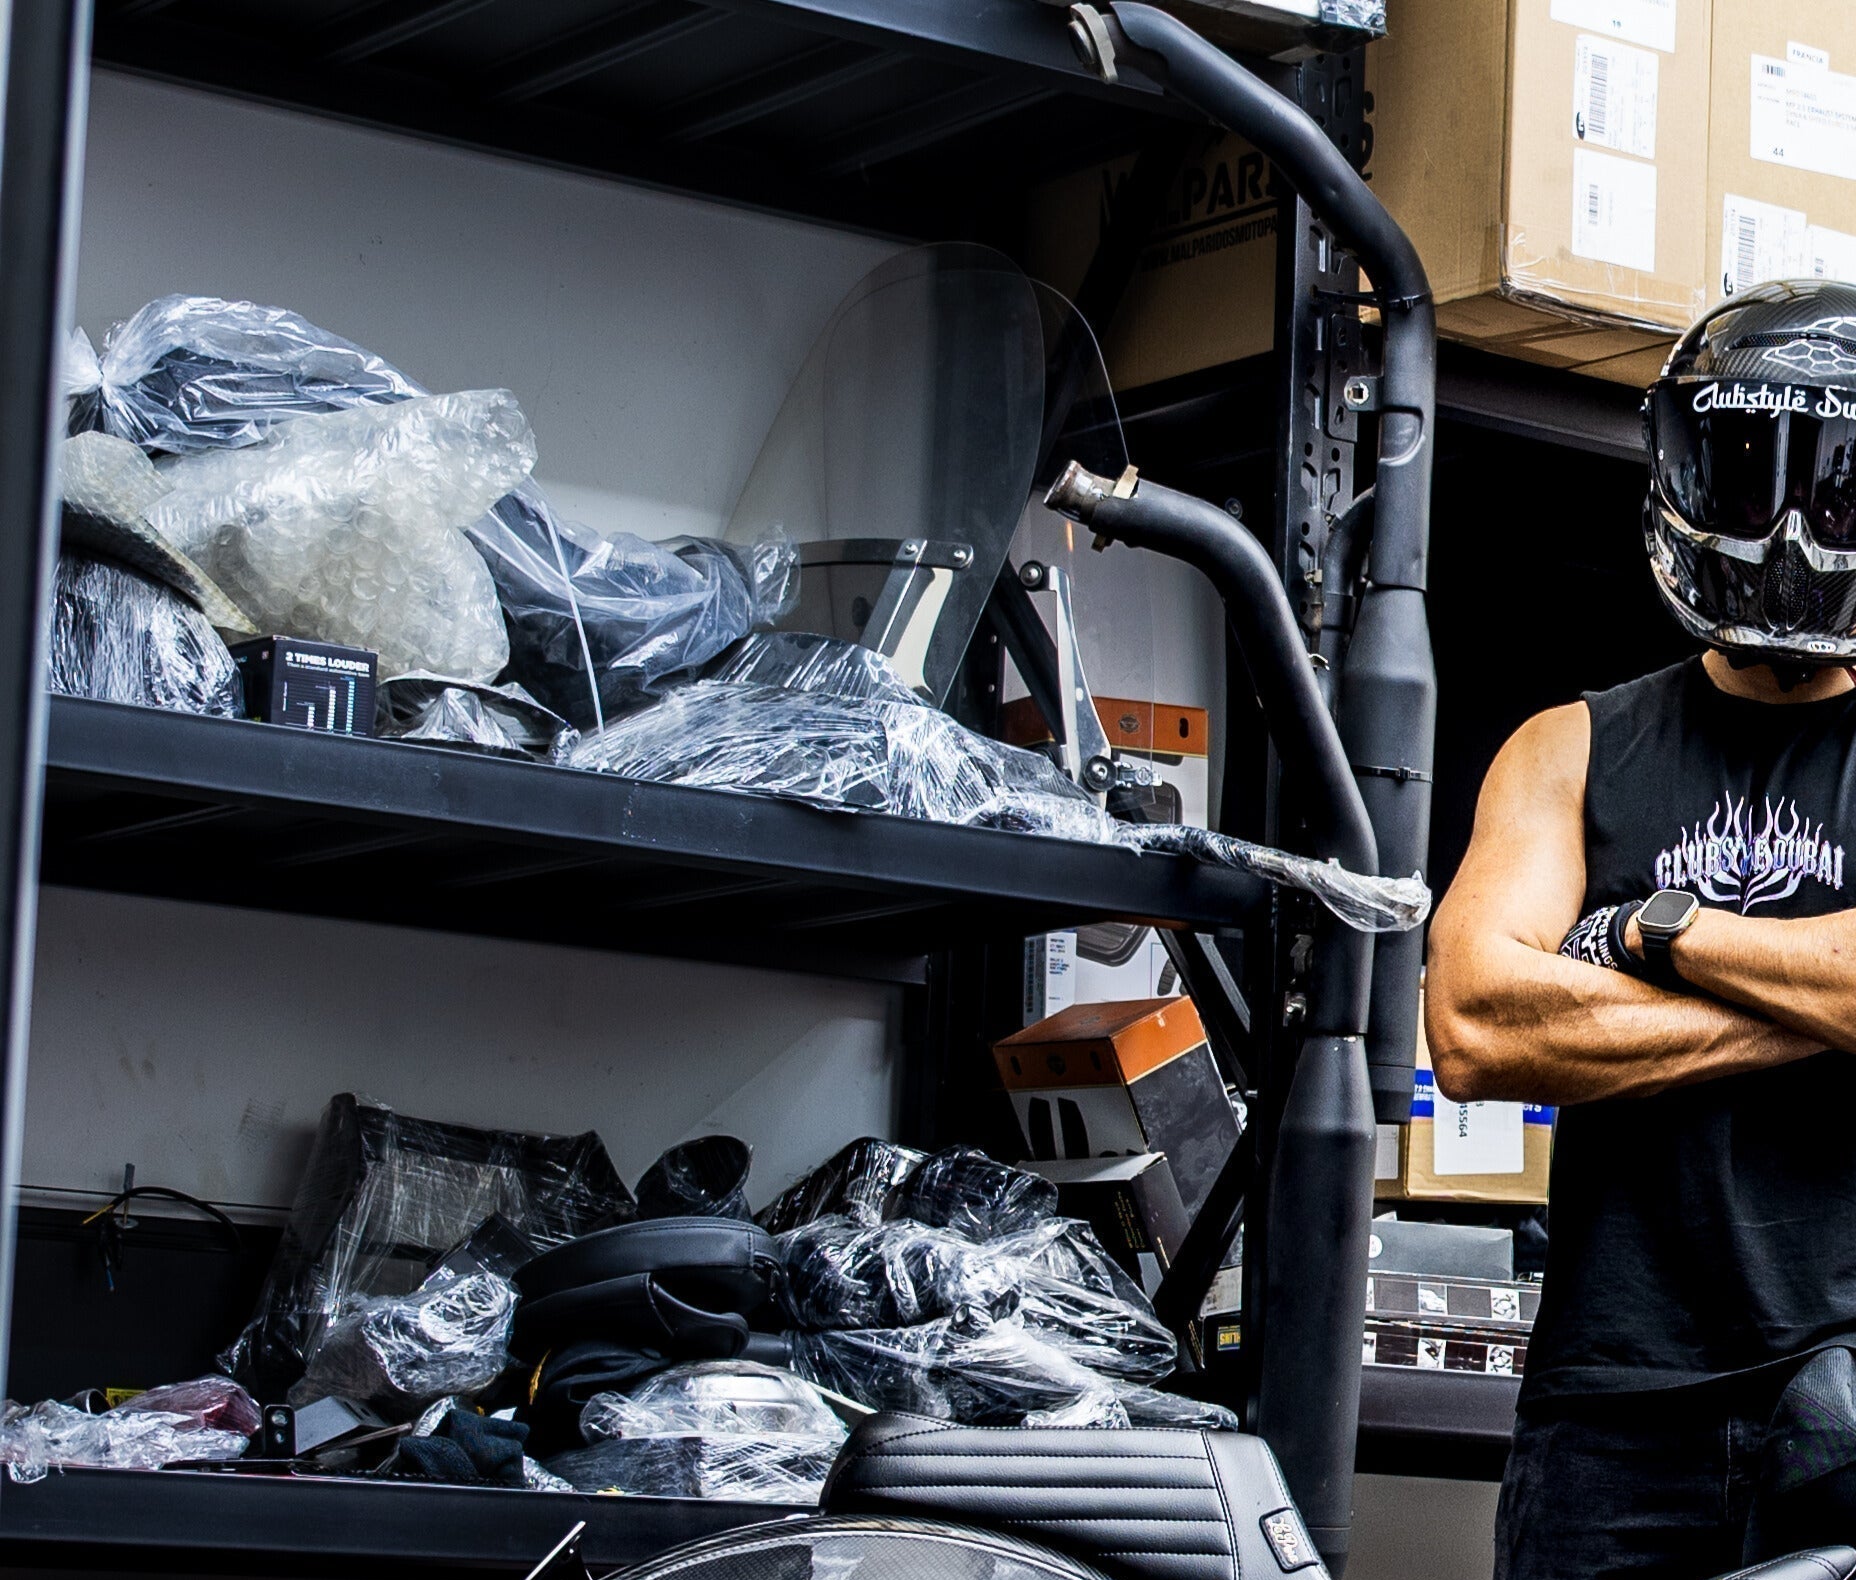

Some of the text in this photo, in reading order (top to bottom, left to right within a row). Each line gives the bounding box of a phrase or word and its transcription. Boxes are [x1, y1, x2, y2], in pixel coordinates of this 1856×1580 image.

[1772, 147, 1784, 157] 44
[295, 652, 327, 667] TIMES
[328, 657, 371, 673] LOUDER
